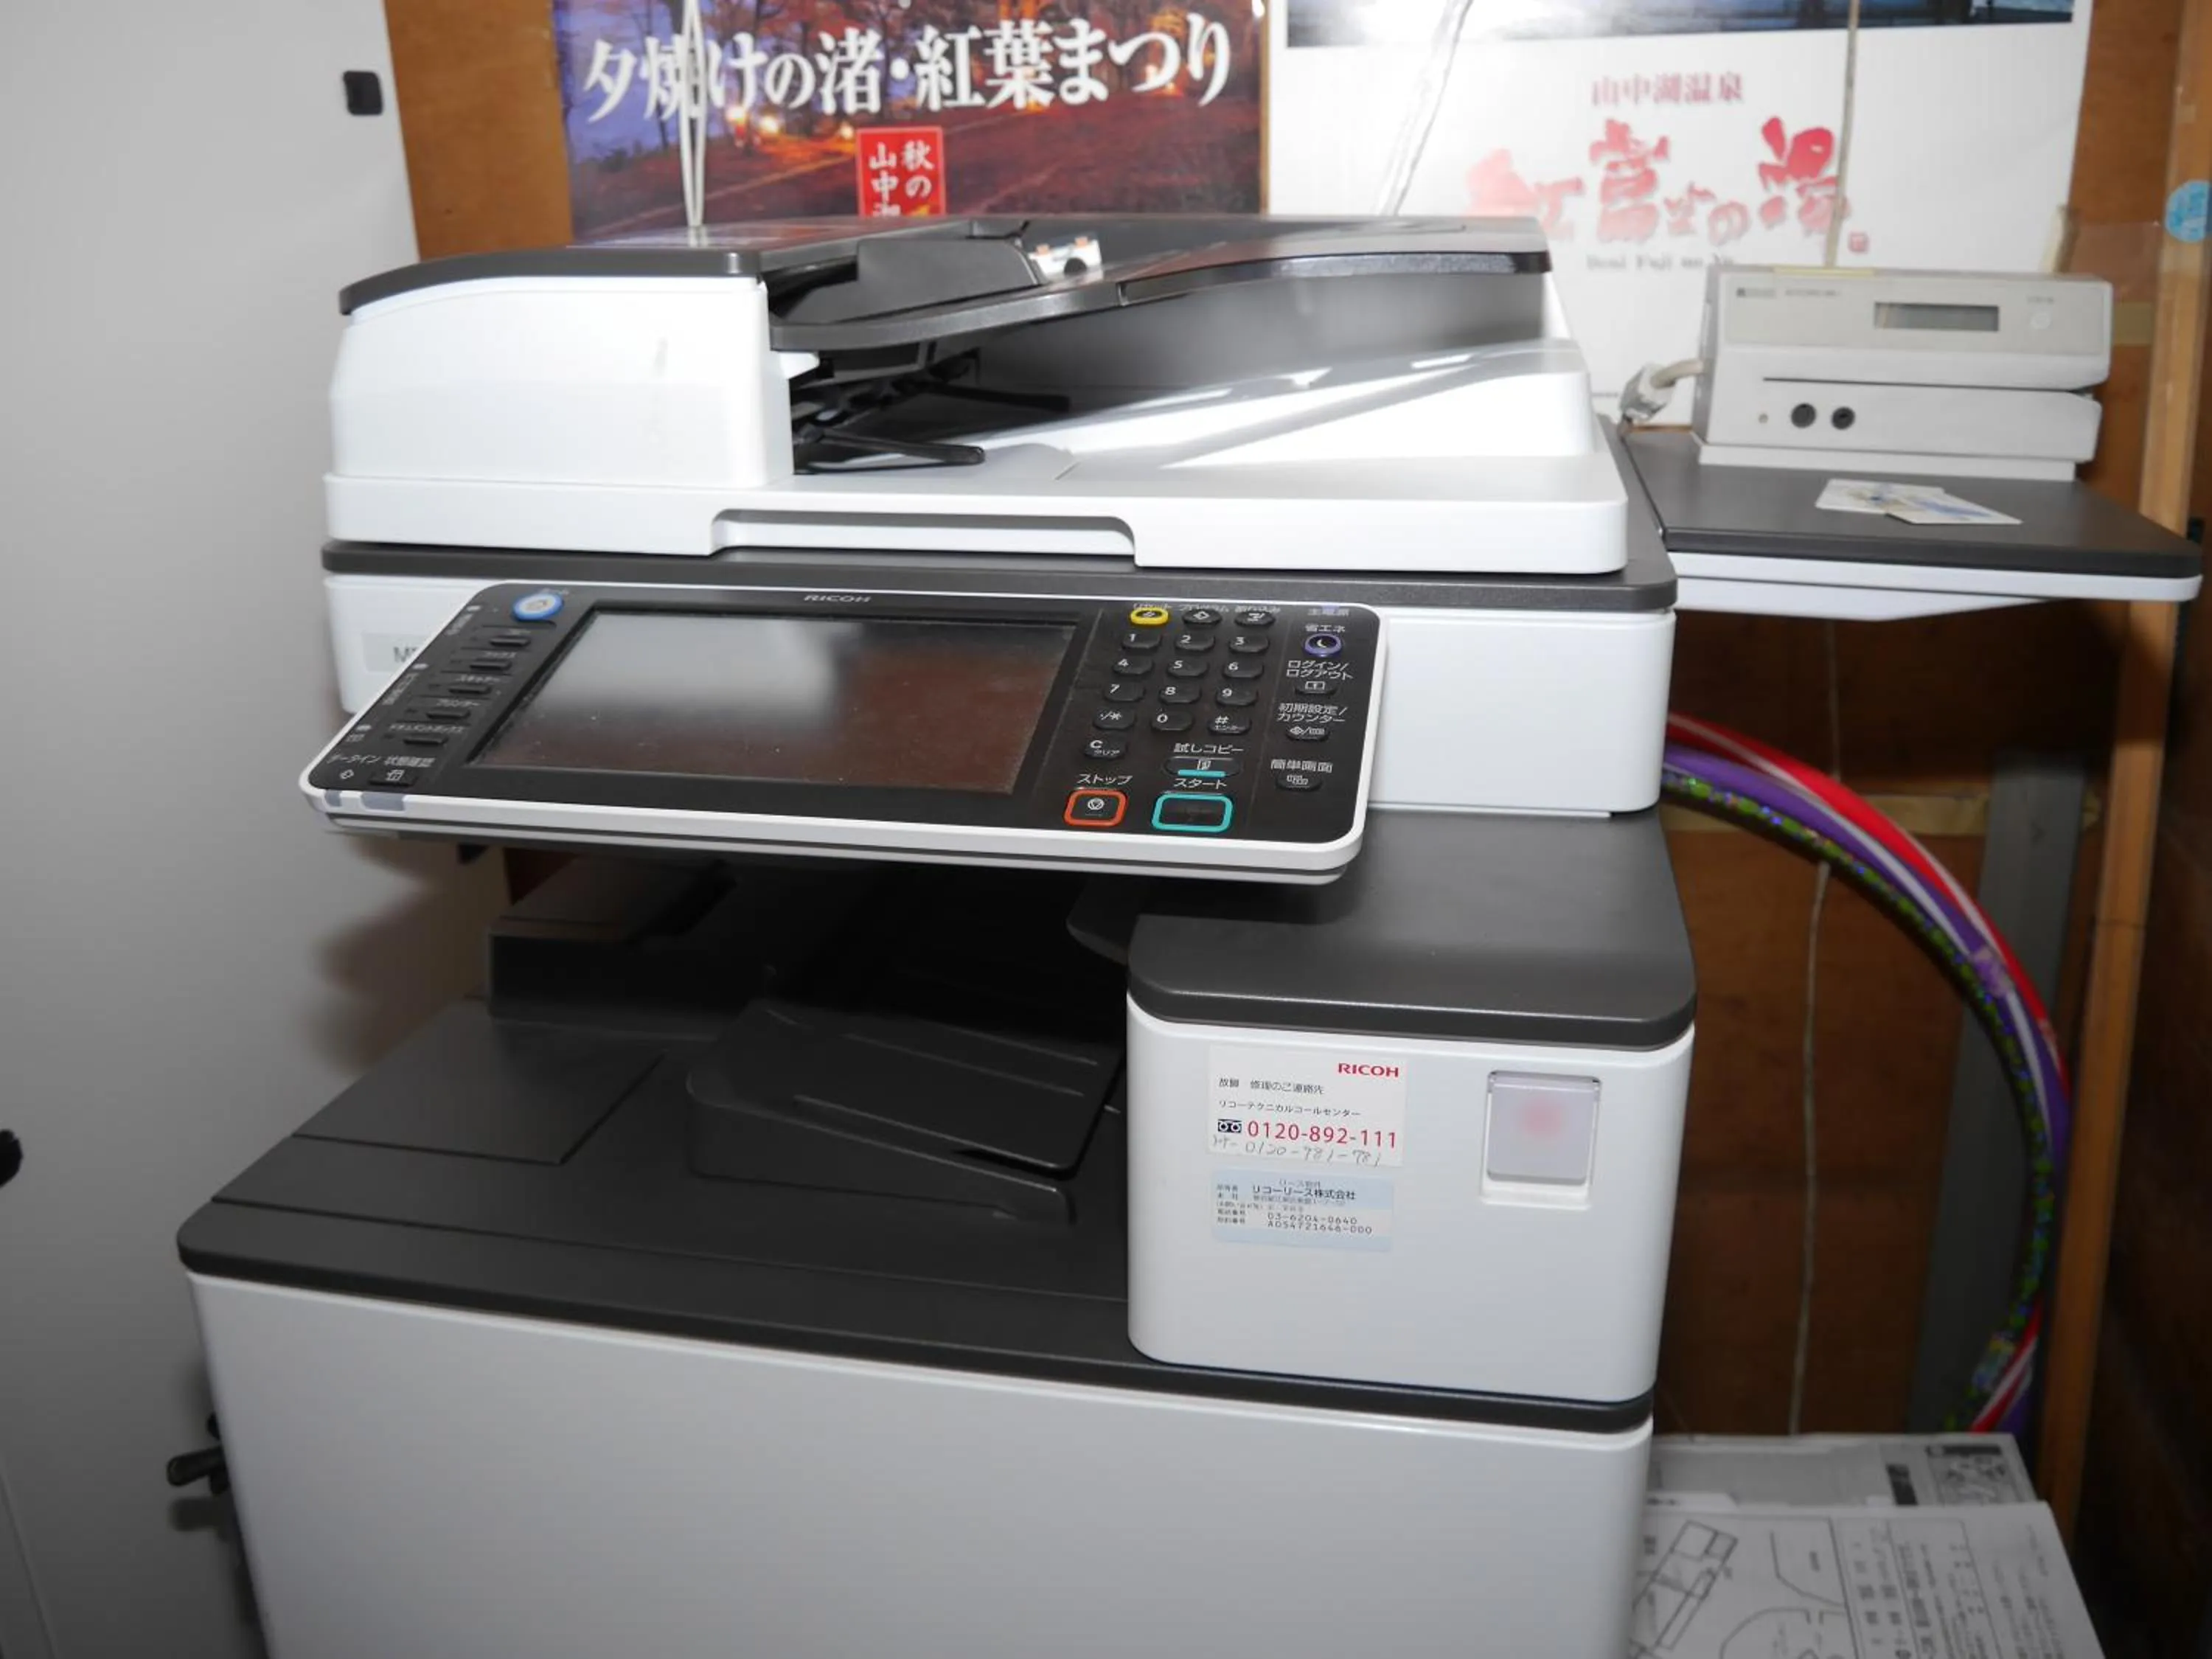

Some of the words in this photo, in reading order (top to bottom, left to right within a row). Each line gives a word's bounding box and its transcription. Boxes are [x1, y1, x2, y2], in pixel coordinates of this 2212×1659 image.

[1591, 71, 1743, 105] 山中湖温泉
[902, 139, 935, 199] 秋の
[1130, 633, 1136, 641] 1
[1180, 635, 1192, 644] 2
[1235, 636, 1245, 645] 3
[1118, 658, 1129, 667] 4
[1173, 661, 1183, 669] 5
[1228, 662, 1238, 670] 6
[1286, 669, 1353, 681] ログアウト
[1110, 684, 1120, 694] 7
[1164, 686, 1176, 695] 8
[1222, 688, 1233, 697] 9
[1157, 714, 1168, 723] 0
[1276, 712, 1346, 723] カウンター
[1090, 740, 1103, 748] C
[1173, 743, 1244, 754] 試しコピー
[1077, 773, 1133, 785] ストップ
[1173, 779, 1228, 790] スタート
[1338, 1062, 1399, 1078] RICOH
[1219, 1100, 1361, 1117] リコーテクニカルコールセンター
[1248, 1121, 1397, 1149] 0120-892-111
[1253, 1186, 1355, 1200] リコーリース株式会社
